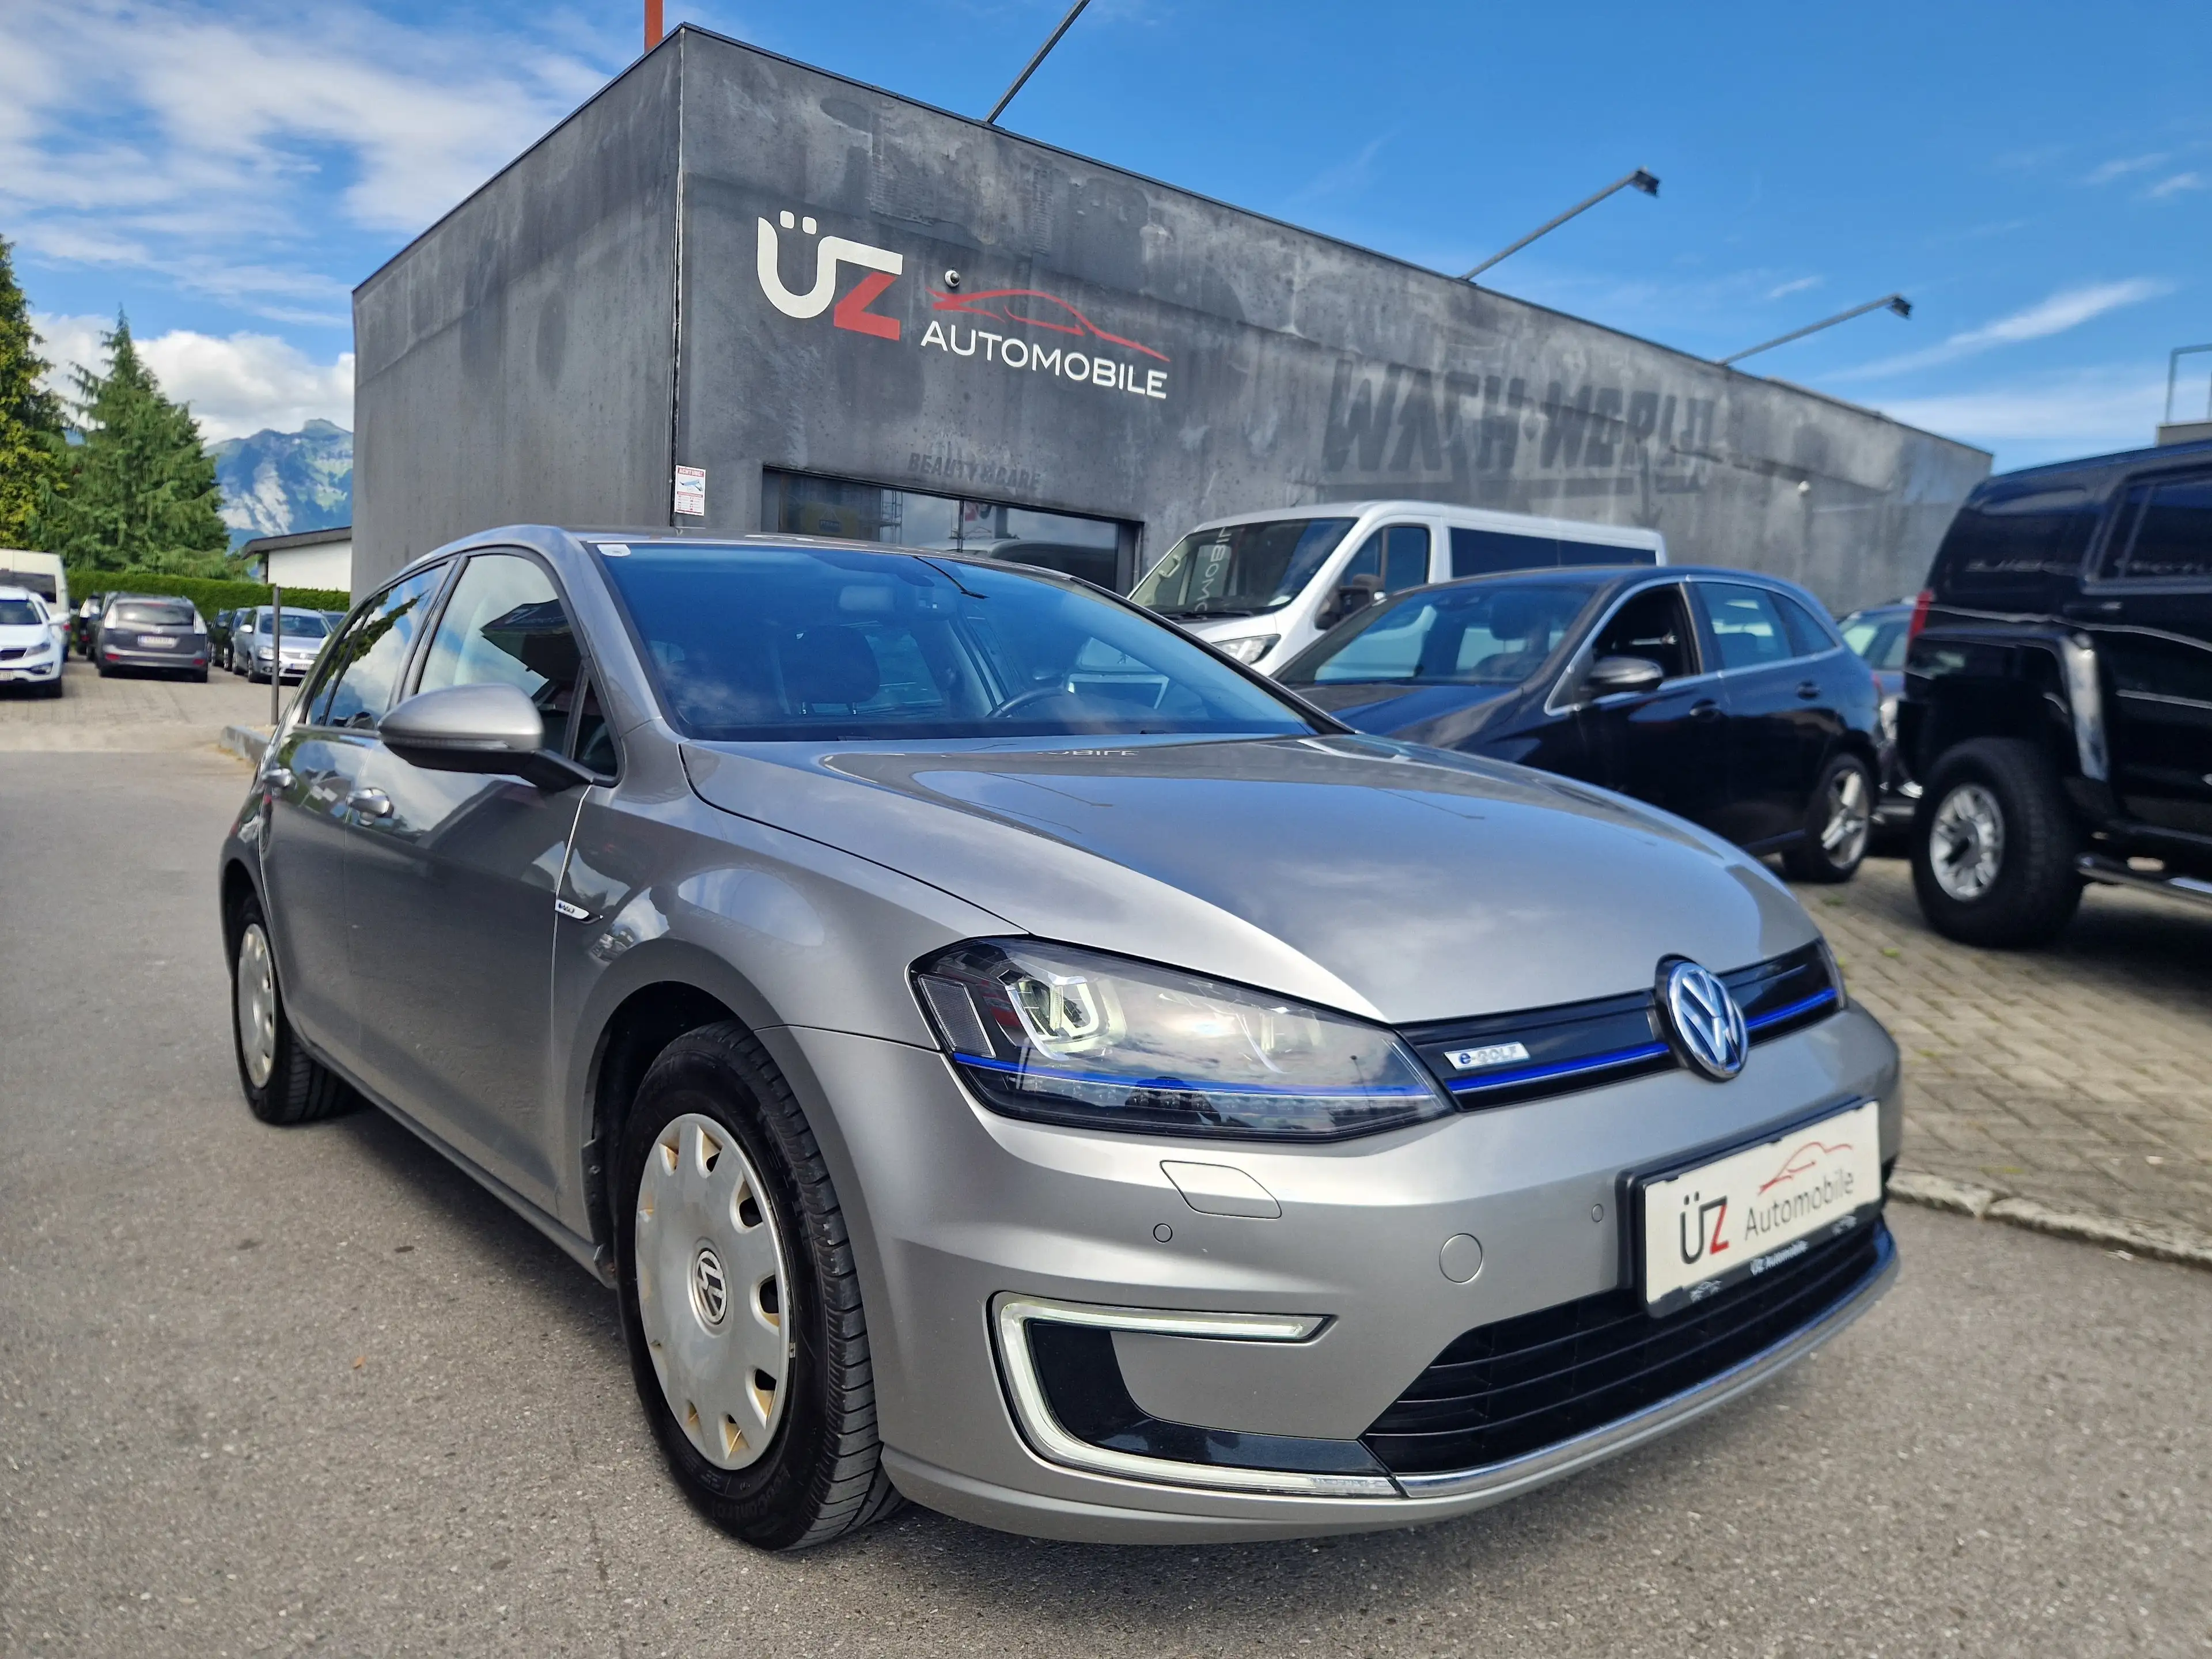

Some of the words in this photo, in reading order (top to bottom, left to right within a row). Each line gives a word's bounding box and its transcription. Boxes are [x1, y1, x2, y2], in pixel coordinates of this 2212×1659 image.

[756, 210, 903, 341] ÜZ
[921, 320, 1168, 399] AUTOMOBILE
[1679, 1191, 1729, 1265] ÜZ
[1744, 1169, 1854, 1241] Automobile
